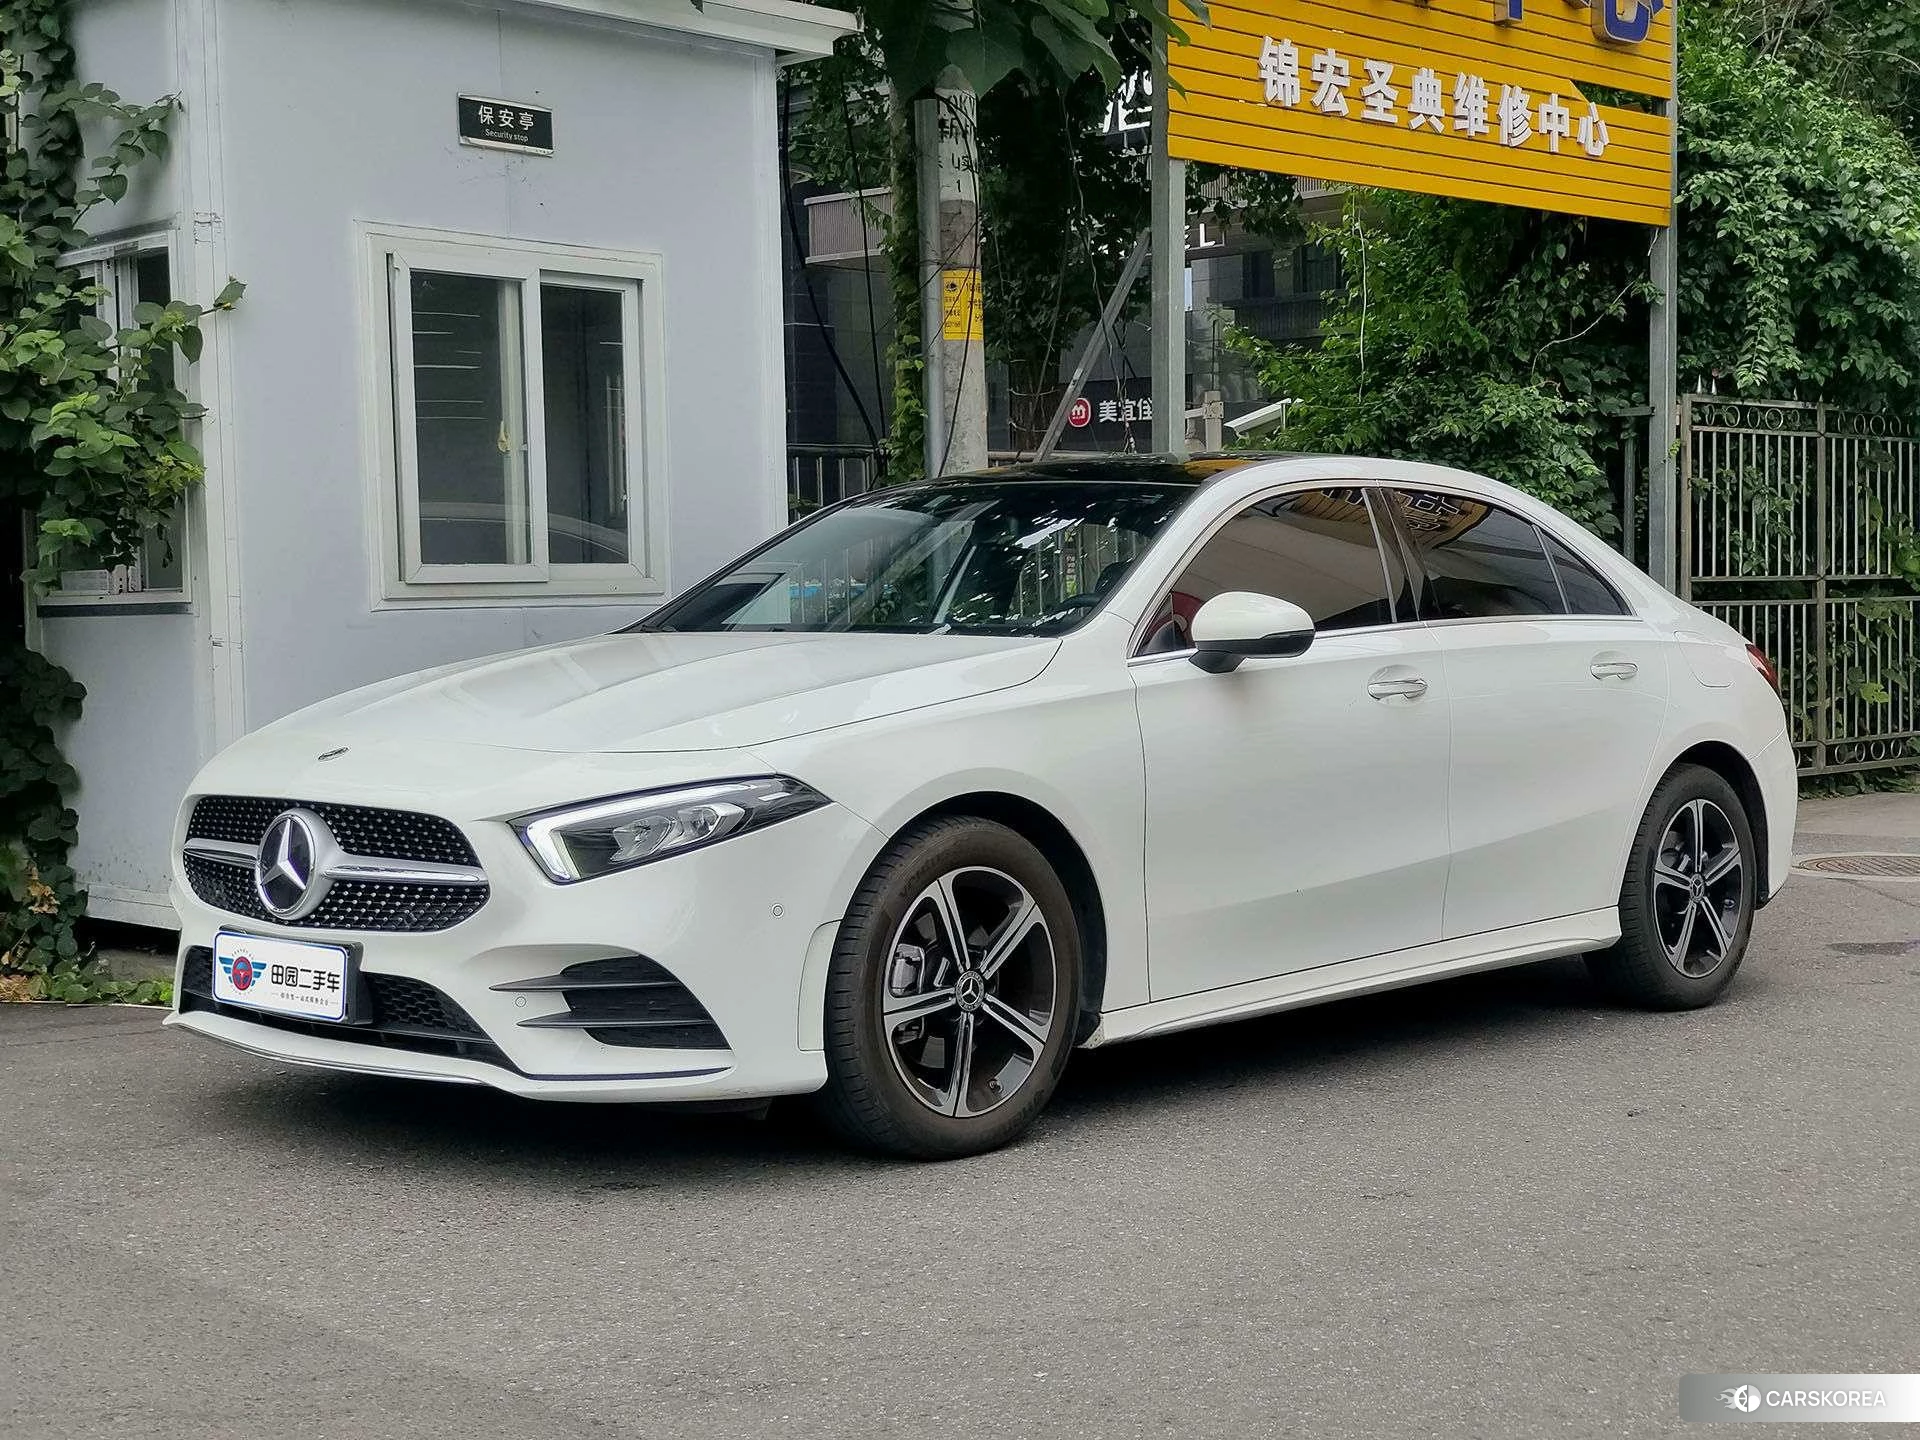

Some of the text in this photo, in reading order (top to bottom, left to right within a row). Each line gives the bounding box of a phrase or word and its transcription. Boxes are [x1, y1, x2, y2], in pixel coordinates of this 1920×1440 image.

[1258, 35, 1609, 157] 锦宏圣典维修中心
[478, 104, 534, 131] 保安亭
[485, 128, 529, 143] Security stop
[271, 964, 340, 993] 田园二手车
